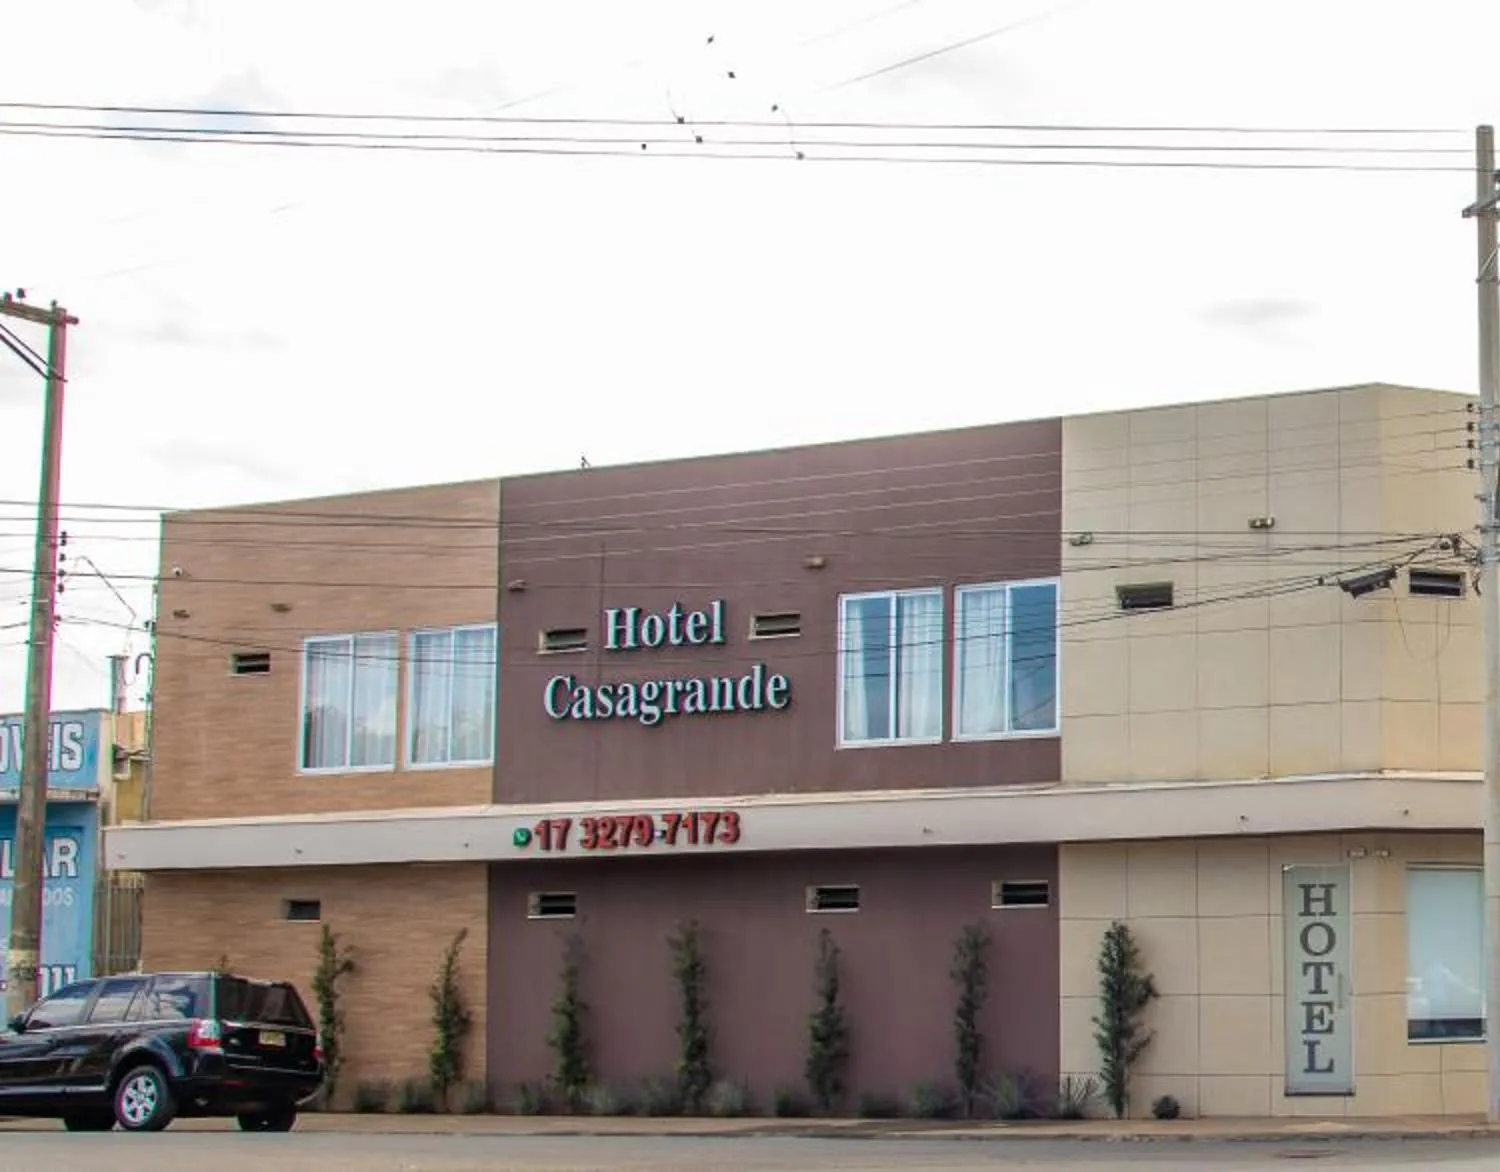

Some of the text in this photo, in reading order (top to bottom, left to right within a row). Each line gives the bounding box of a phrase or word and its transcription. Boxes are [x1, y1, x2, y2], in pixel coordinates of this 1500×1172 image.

[603, 599, 727, 650] Hotel
[543, 663, 791, 726] Casagrande
[534, 811, 742, 851] 17 3279-7173
[1297, 883, 1338, 1074] HOTEL
